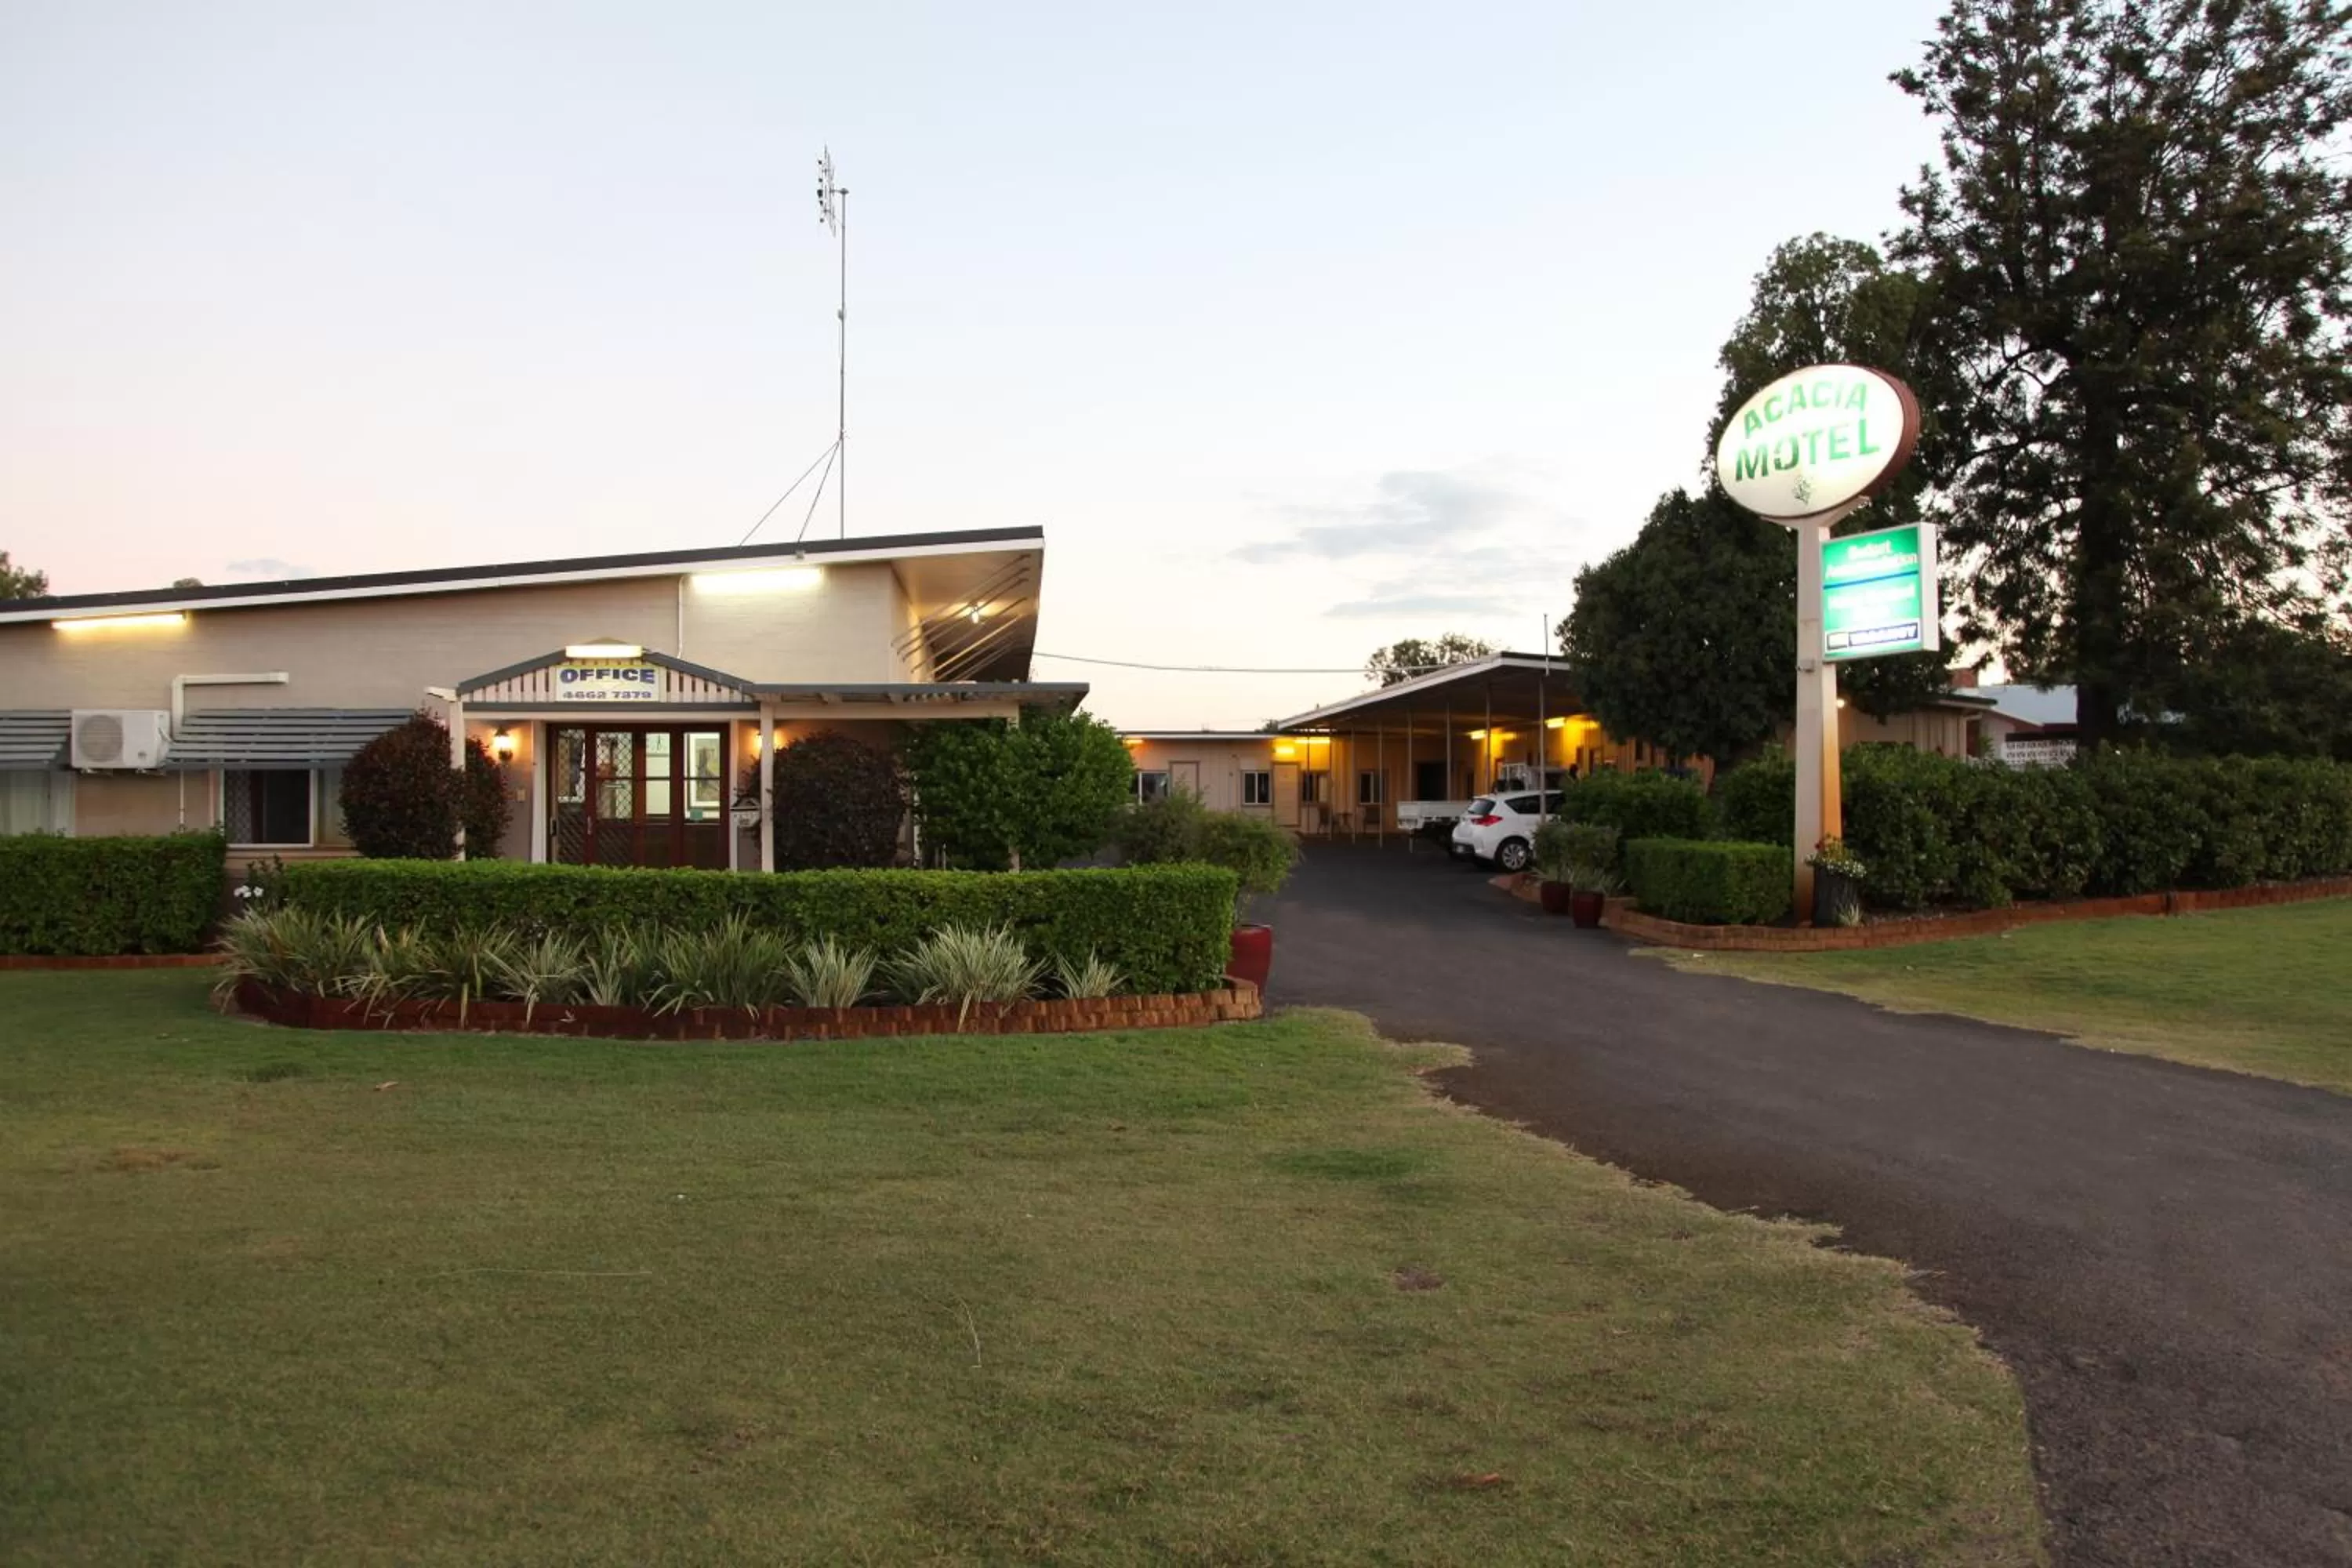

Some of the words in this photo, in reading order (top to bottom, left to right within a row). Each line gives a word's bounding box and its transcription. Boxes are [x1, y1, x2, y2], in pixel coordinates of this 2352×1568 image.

[1743, 380, 1867, 439] ACACIA
[1735, 418, 1880, 481] MOTEL
[560, 668, 655, 684] OFFICE
[563, 691, 607, 699] 4662
